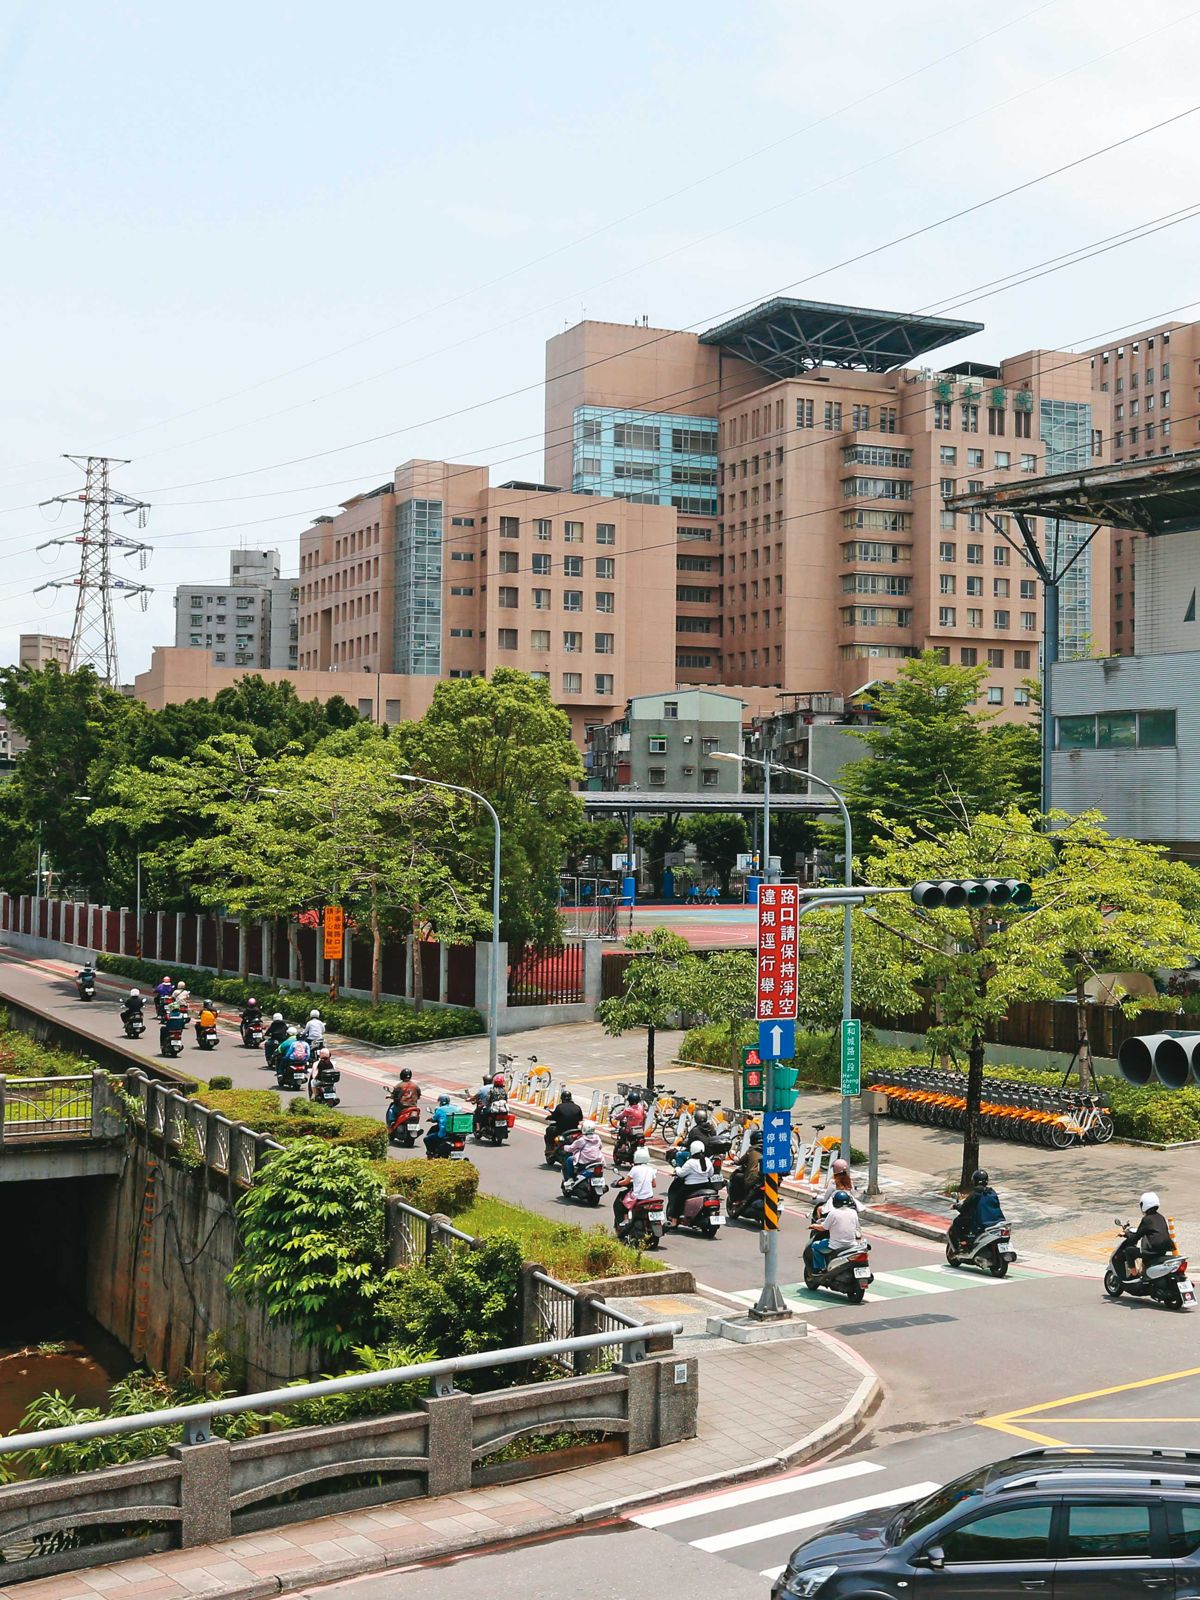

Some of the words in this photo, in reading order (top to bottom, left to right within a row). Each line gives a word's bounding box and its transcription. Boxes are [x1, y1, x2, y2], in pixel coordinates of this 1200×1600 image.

[760, 889, 776, 1016] 違規逕行舉發
[779, 889, 795, 1015] 路口請保持淨空
[847, 1027, 855, 1072] 和城路一段
[766, 1133, 776, 1170] 停車場
[779, 1132, 788, 1168] 機車
